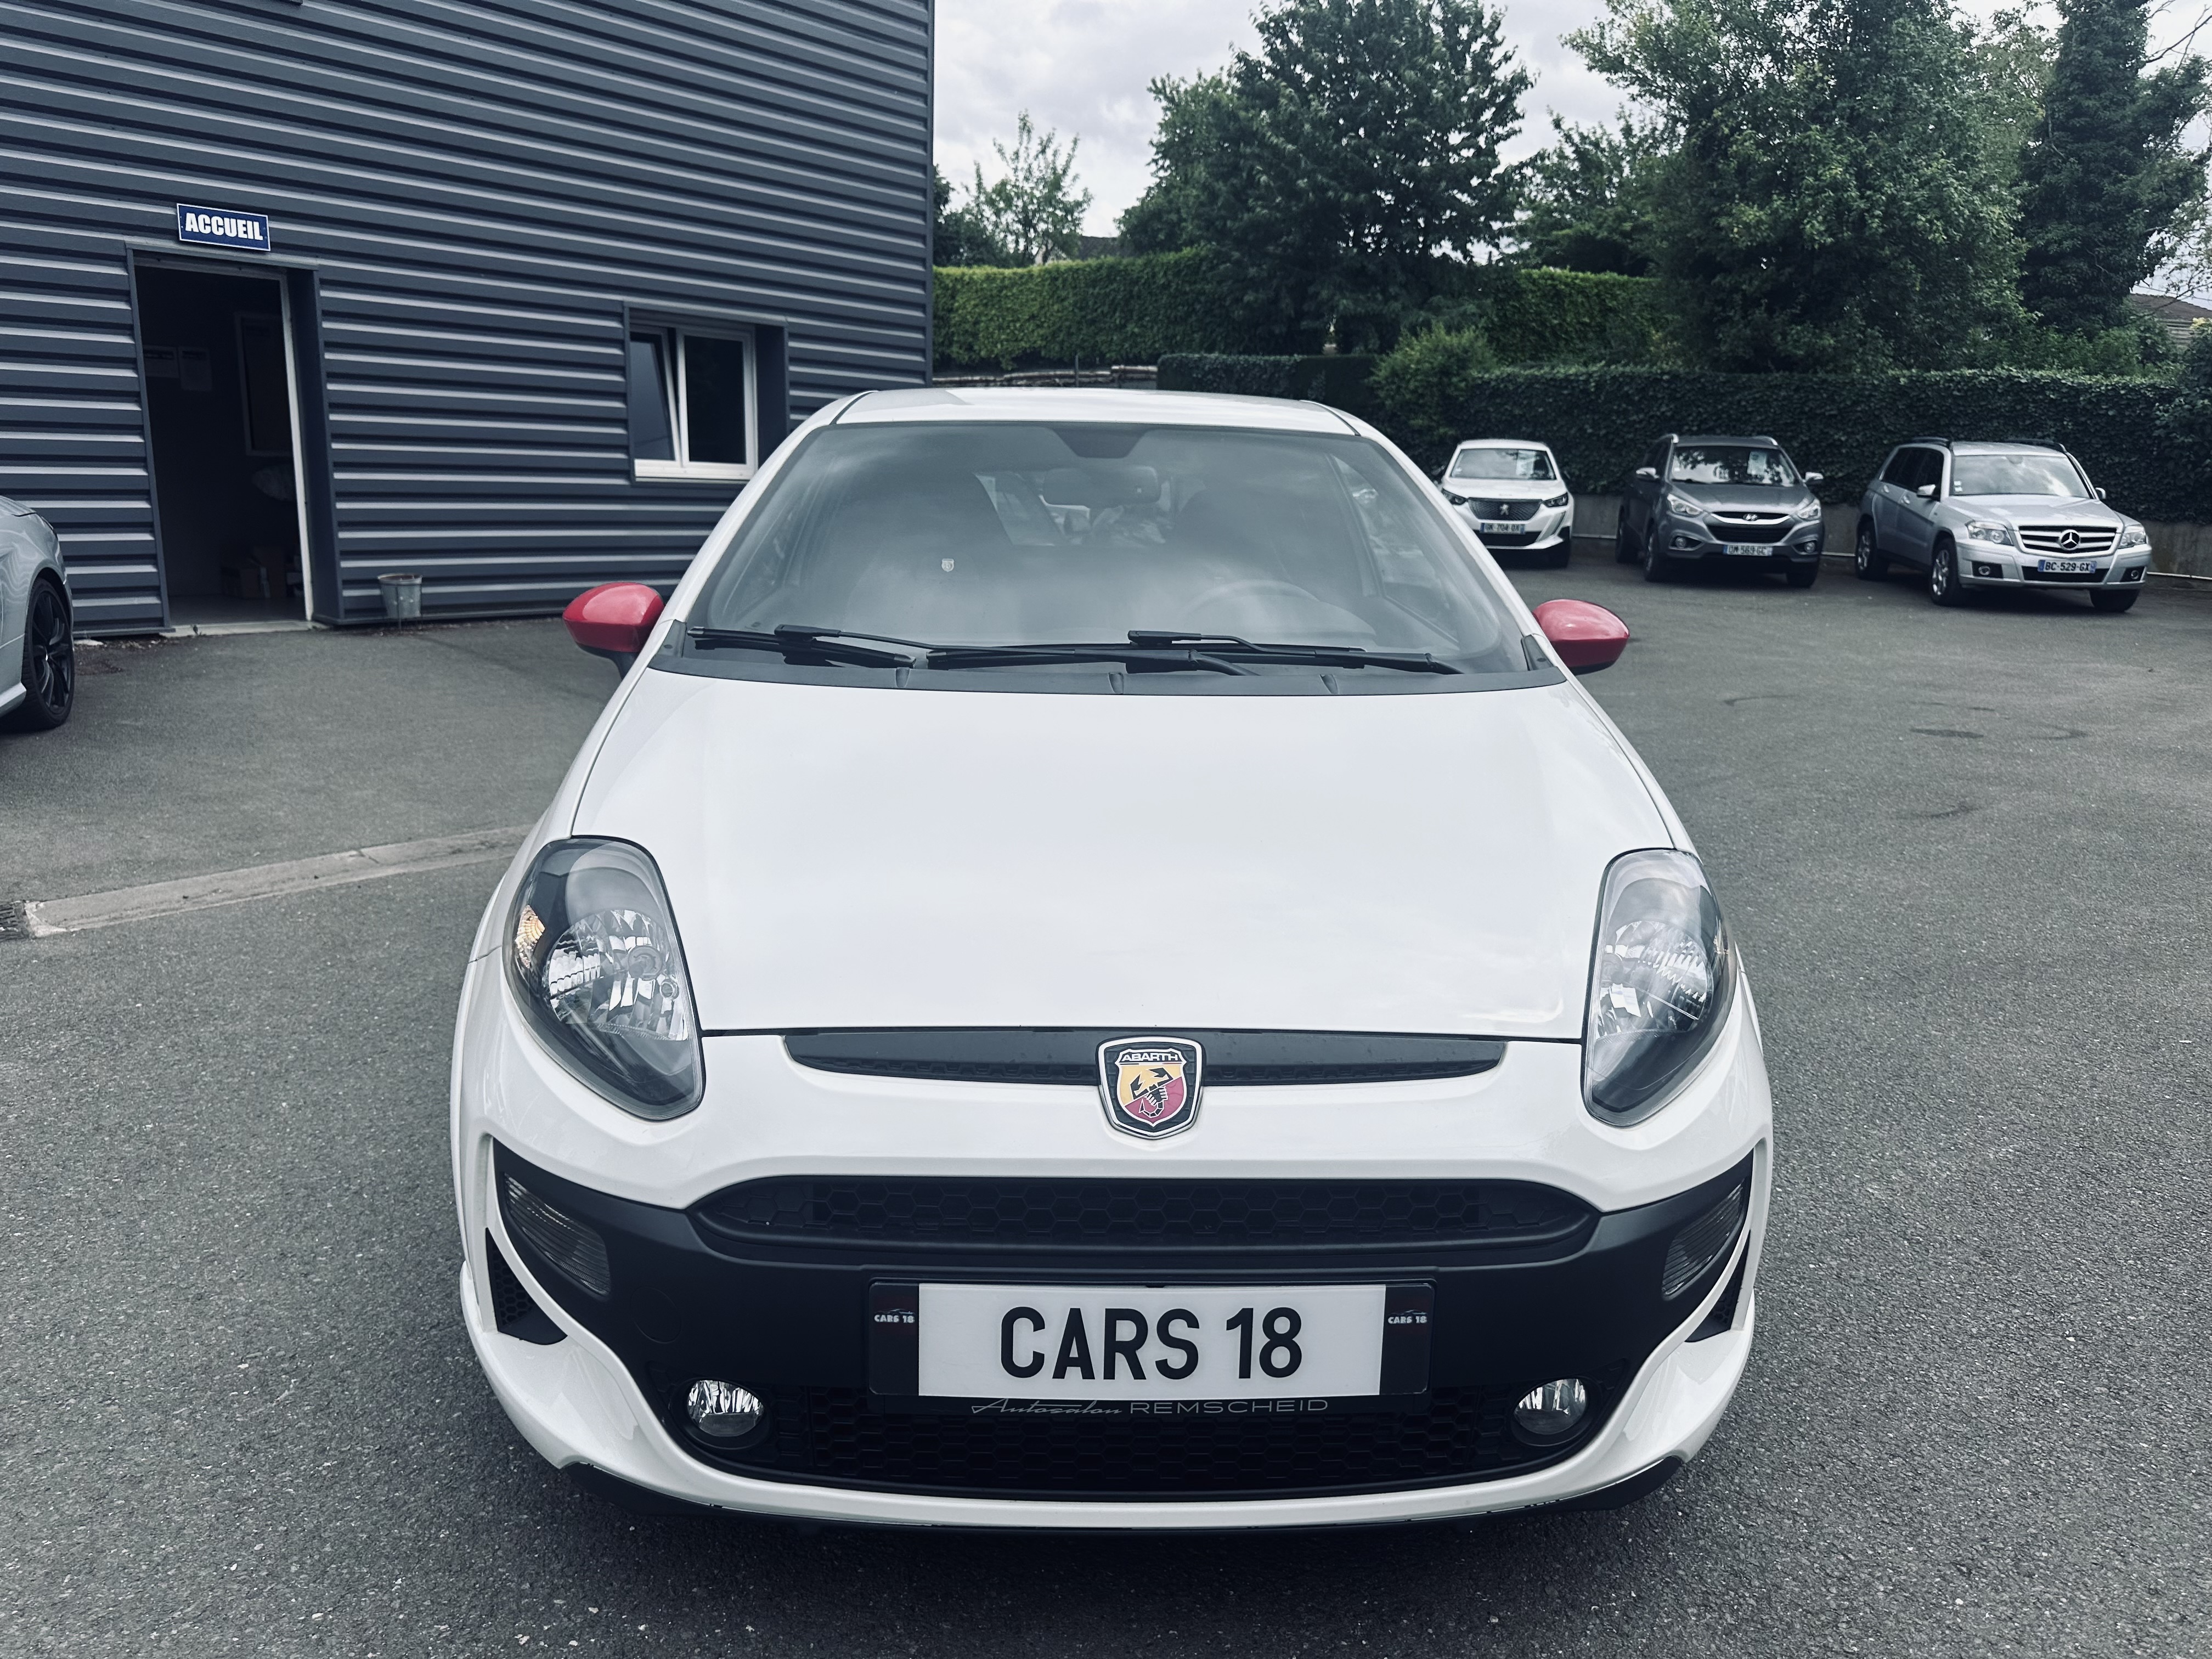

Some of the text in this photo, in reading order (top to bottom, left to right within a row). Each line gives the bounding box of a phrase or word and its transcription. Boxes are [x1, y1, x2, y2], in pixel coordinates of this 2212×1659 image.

[185, 212, 263, 241] ACCUEIL
[2045, 561, 2090, 572] BC-529-GX
[1122, 1052, 1178, 1062] ABARTH
[874, 1314, 915, 1323] CARS 18
[1387, 1316, 1427, 1324] CARS 18
[1001, 1306, 1302, 1380] CARS 18
[972, 1398, 1328, 1414] Autosalon REMSCHEID
